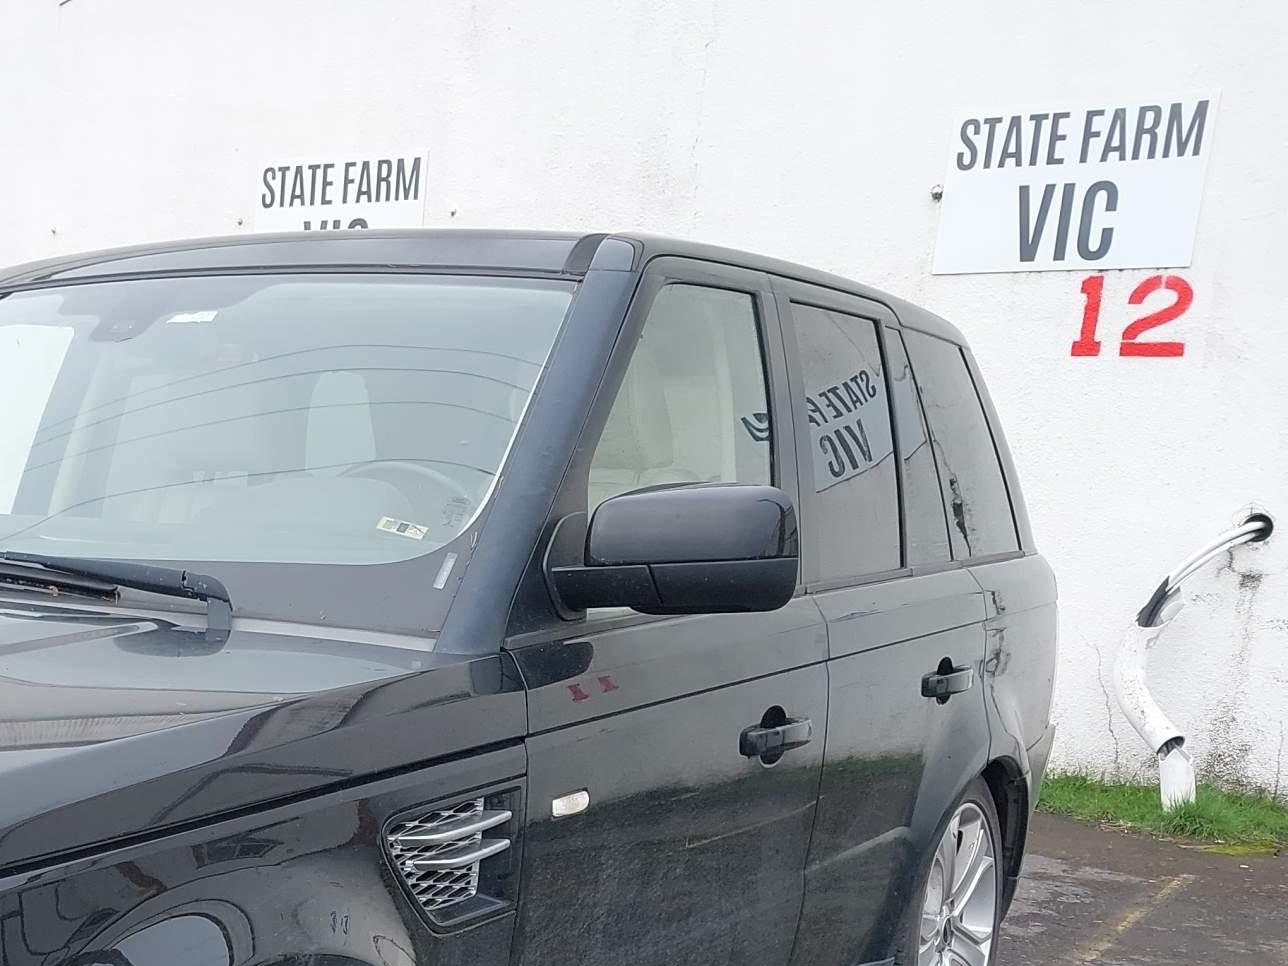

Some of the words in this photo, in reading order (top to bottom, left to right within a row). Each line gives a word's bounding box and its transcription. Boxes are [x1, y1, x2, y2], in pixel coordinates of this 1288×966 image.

[956, 111, 1071, 171] STATE
[1078, 99, 1210, 164] FARM
[261, 163, 335, 209] STATE
[342, 156, 421, 205] FARM
[1018, 180, 1119, 262] VIC
[1070, 275, 1194, 357] 12
